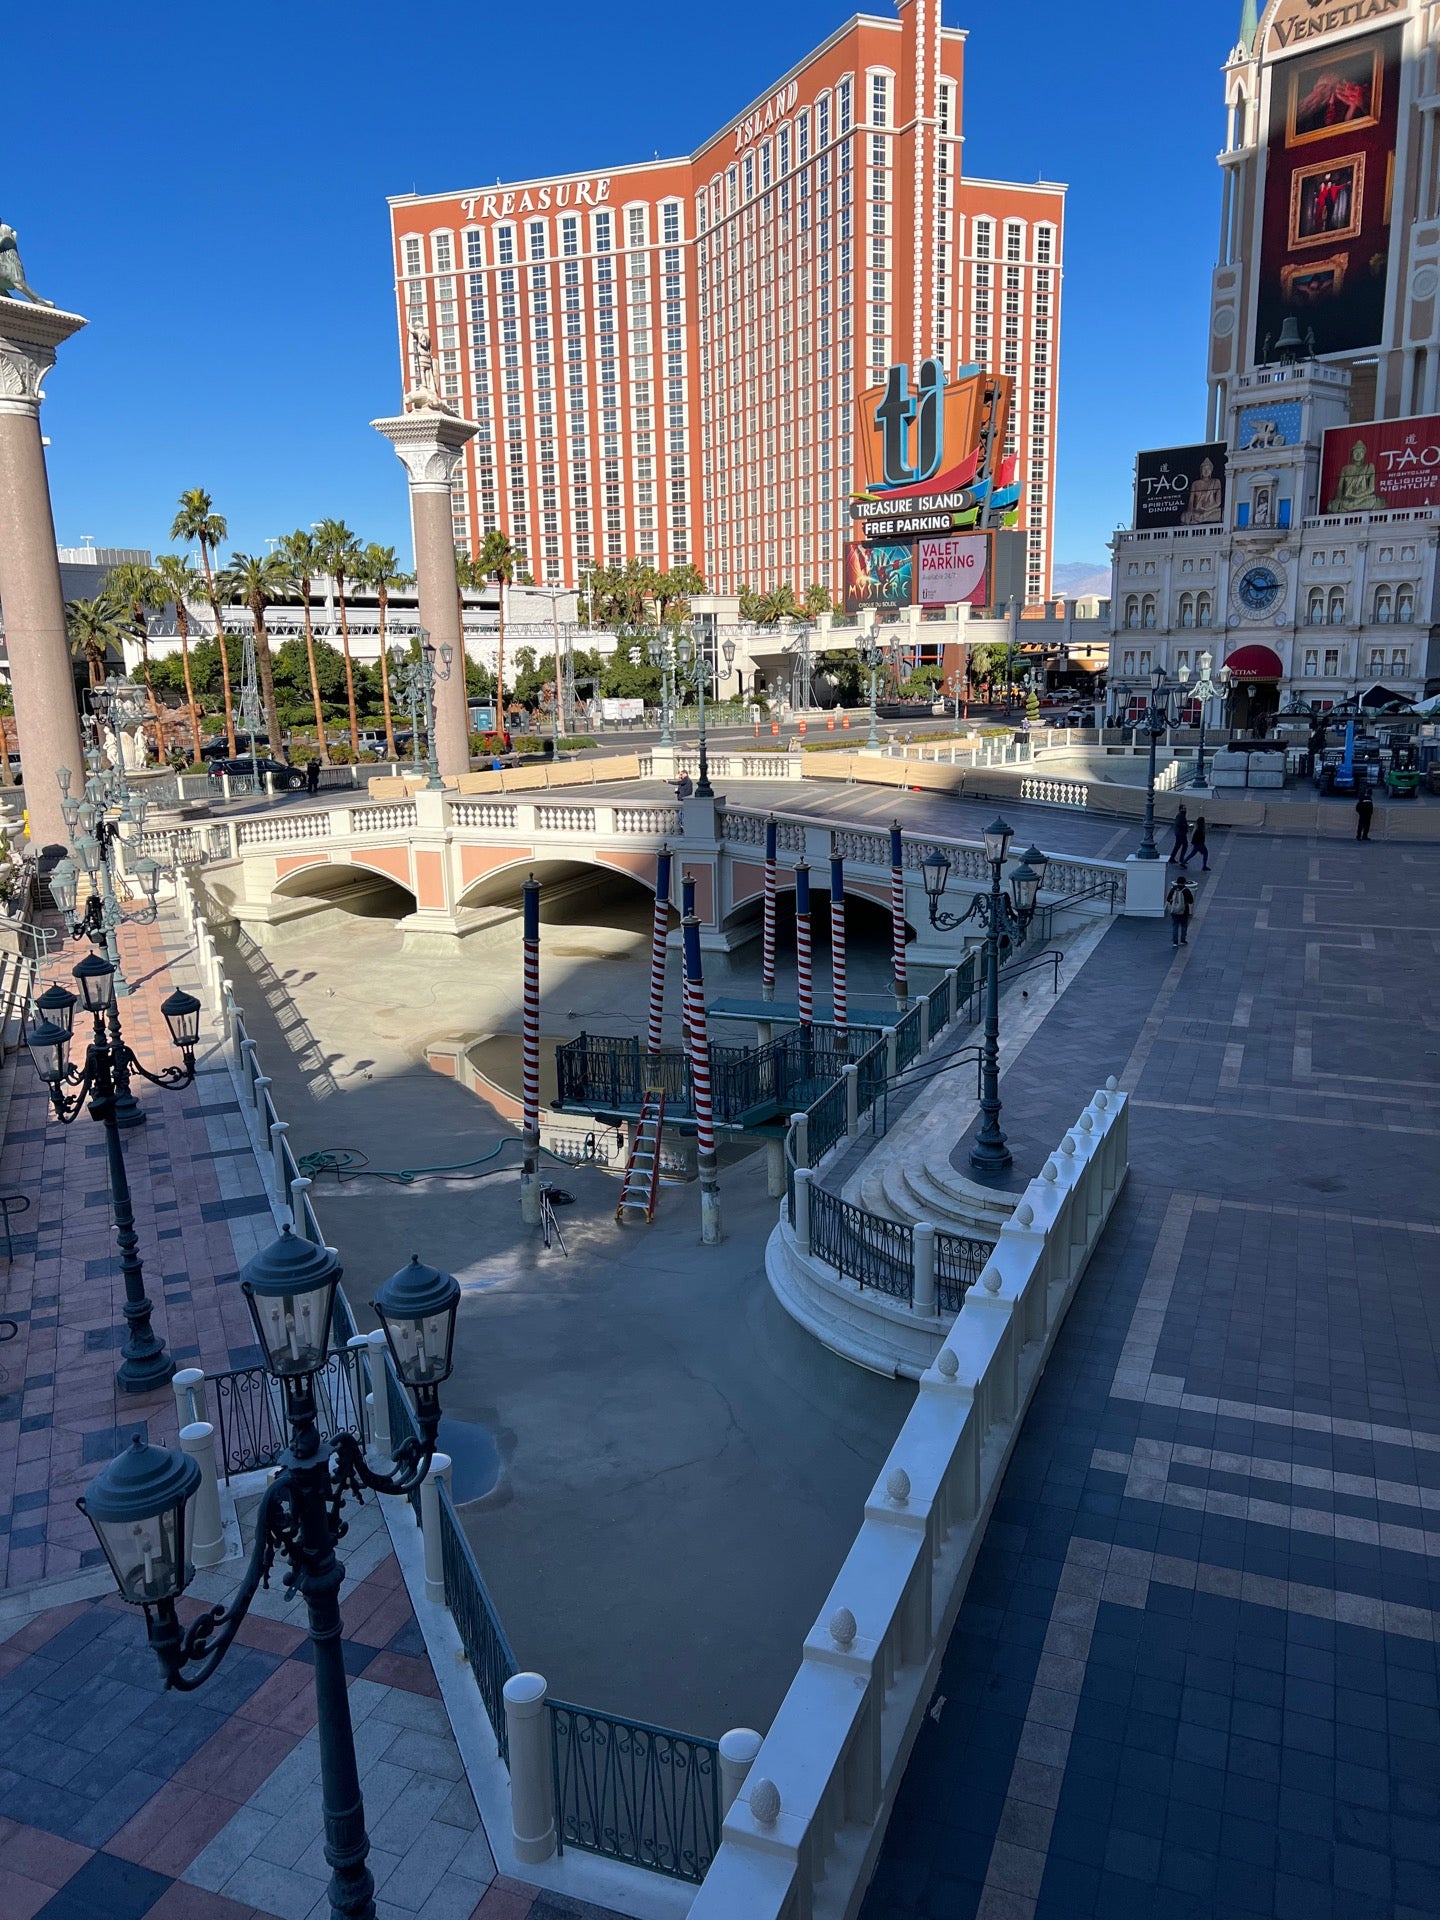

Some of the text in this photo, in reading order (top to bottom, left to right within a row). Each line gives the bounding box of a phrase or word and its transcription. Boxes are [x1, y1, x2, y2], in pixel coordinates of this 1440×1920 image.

[1271, 0, 1400, 48] VENETIAN
[460, 80, 799, 220] TREASURE ISLAND
[1379, 445, 1440, 471] TAO
[1140, 474, 1188, 495] TAO
[1380, 475, 1438, 486] RELIGIOUS
[1380, 481, 1436, 492] NIGHTLIFE
[856, 493, 963, 517] TREASURE ISLAND
[1142, 500, 1185, 509] SPIRITUAL
[865, 515, 950, 535] FREE PARKING
[921, 541, 959, 557] VALET
[921, 554, 974, 571] PARKING
